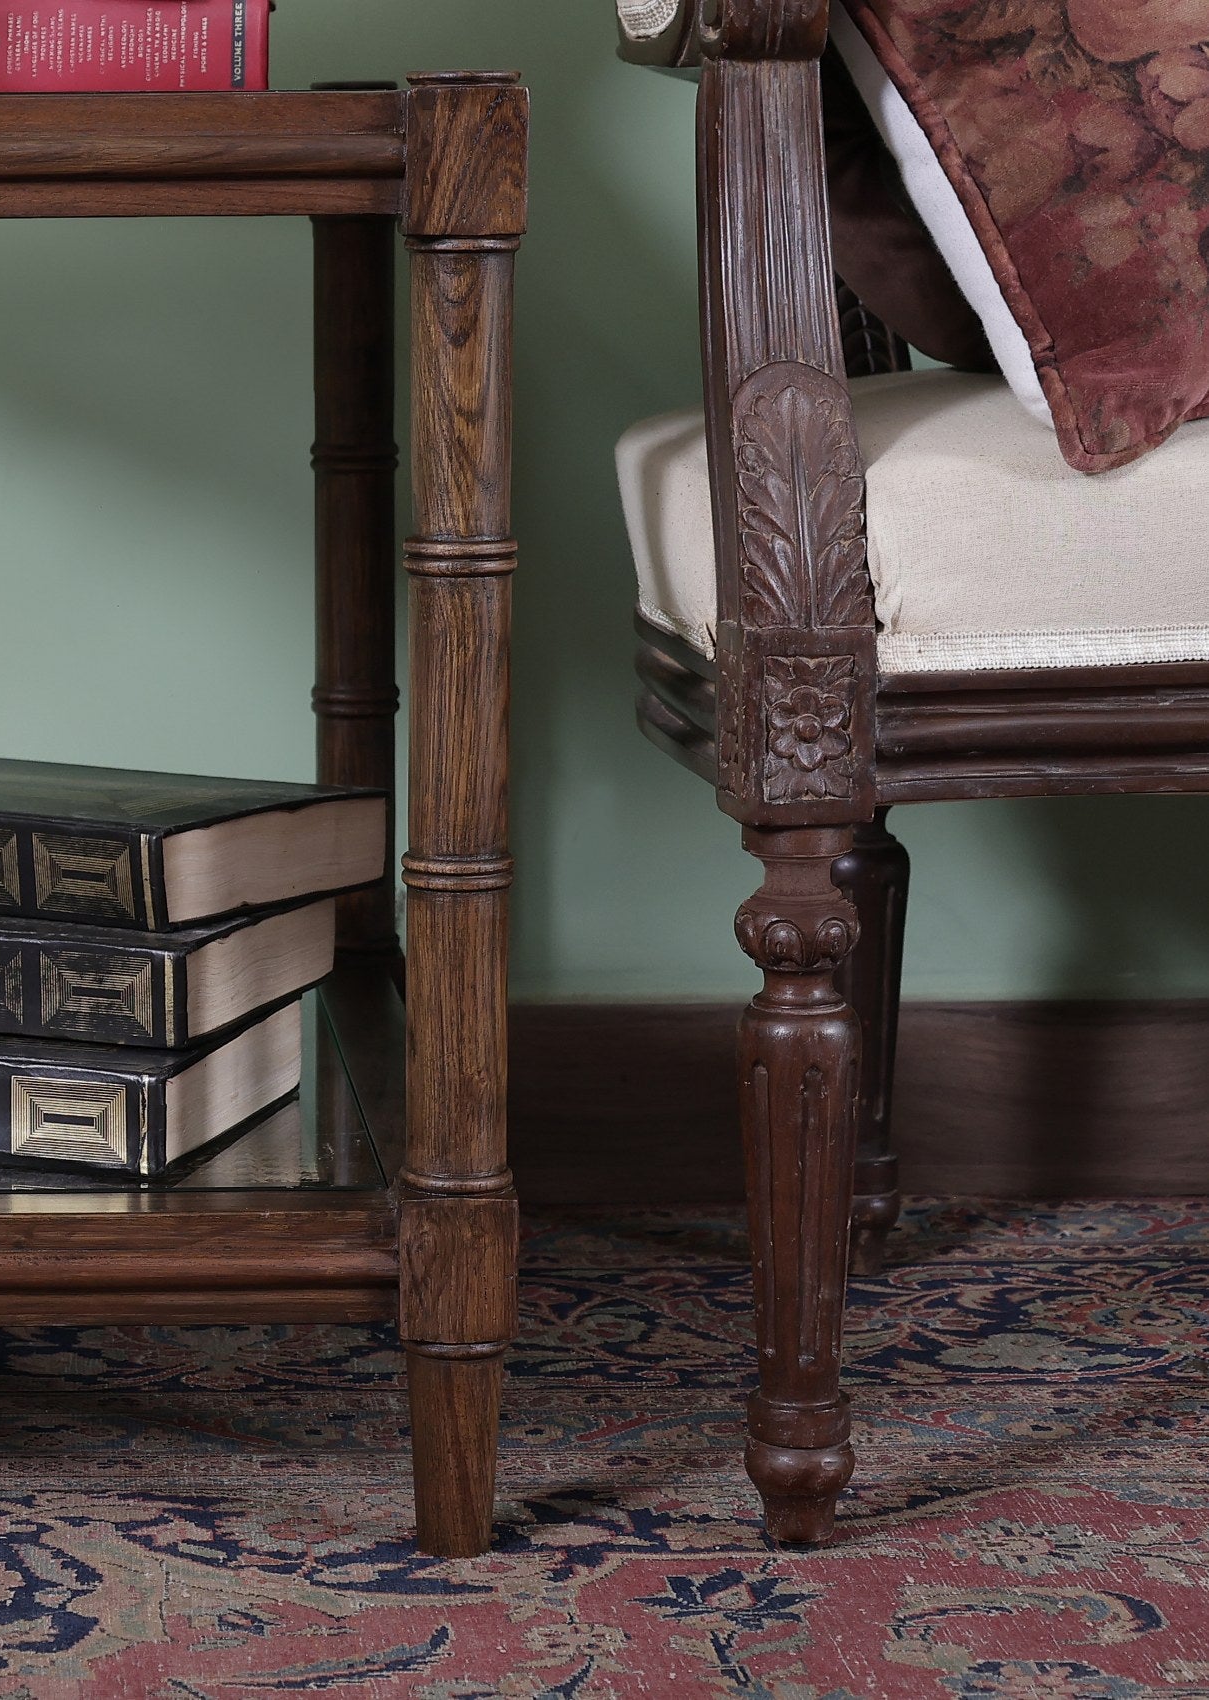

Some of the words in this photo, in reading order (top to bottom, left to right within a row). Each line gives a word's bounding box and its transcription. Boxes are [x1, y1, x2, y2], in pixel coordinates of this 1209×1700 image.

[32, 30, 38, 40] OF
[179, 1, 187, 53] ANTHROPOLOGY
[234, 2, 243, 37] THREE
[233, 40, 242, 81] VOLUME
